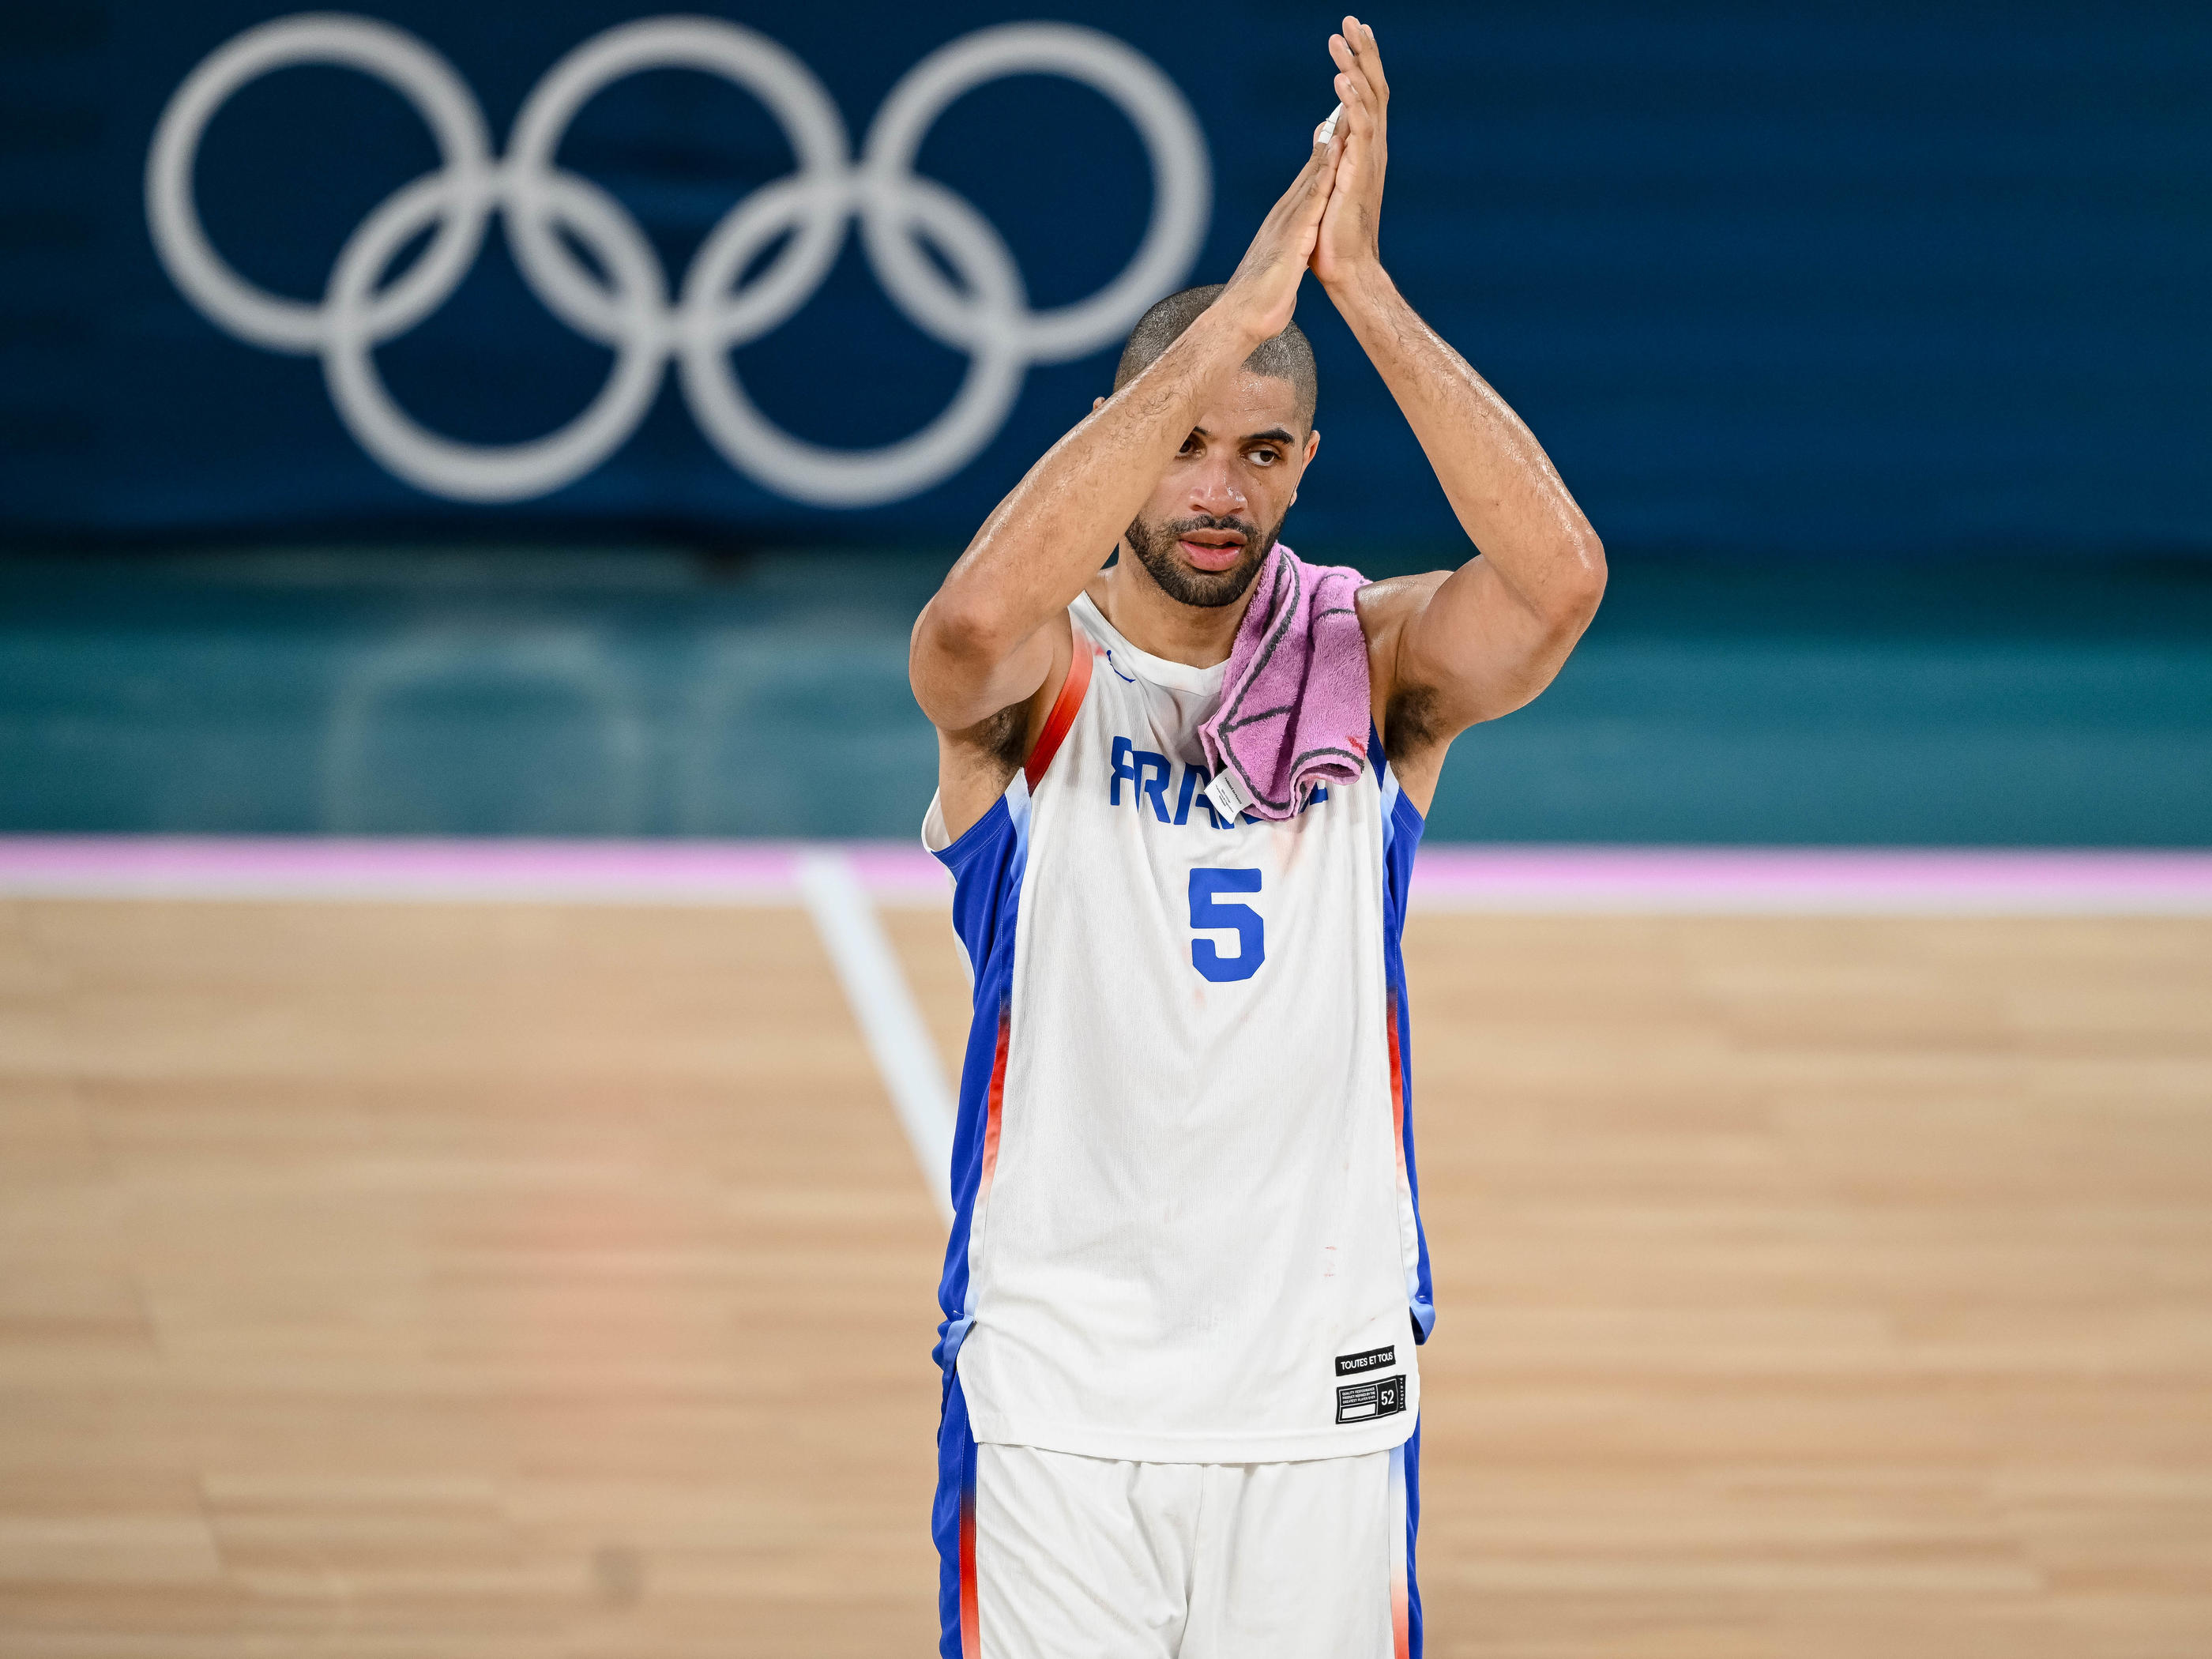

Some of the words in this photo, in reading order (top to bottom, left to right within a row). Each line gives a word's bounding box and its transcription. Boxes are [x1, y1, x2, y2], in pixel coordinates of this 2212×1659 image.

[1111, 736, 1328, 830] FRA
[1188, 868, 1265, 982] 5
[1341, 1357, 1368, 1370] TOUTES
[1369, 1355, 1377, 1365] ET
[1378, 1352, 1393, 1362] TOUS
[1381, 1390, 1394, 1405] 52
